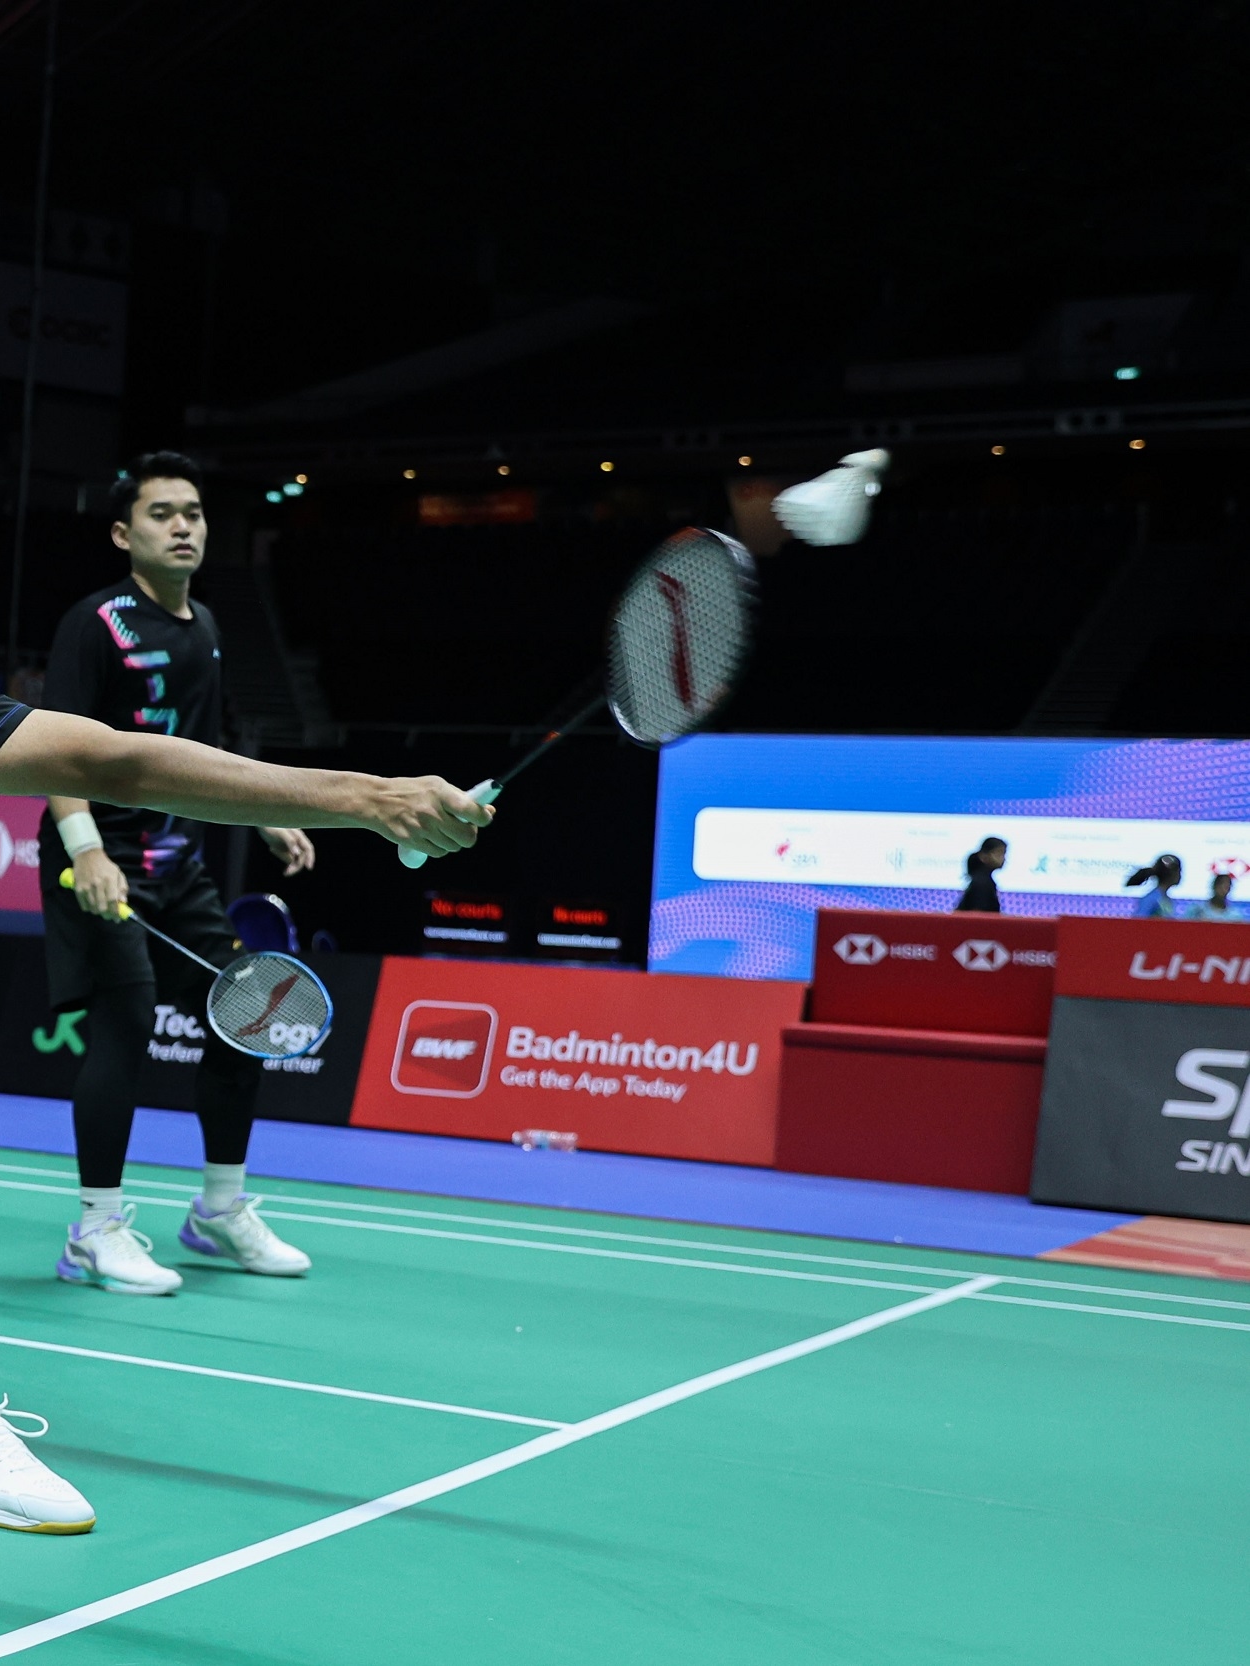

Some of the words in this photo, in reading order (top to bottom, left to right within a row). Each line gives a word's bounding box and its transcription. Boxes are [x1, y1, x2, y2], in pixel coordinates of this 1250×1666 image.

[890, 942, 938, 961] HSBC
[411, 1036, 478, 1060] BWF
[506, 1025, 759, 1076] Badminton4U
[500, 1065, 537, 1088] Get
[539, 1068, 574, 1090] the
[574, 1071, 621, 1097] App
[623, 1074, 688, 1103] Today
